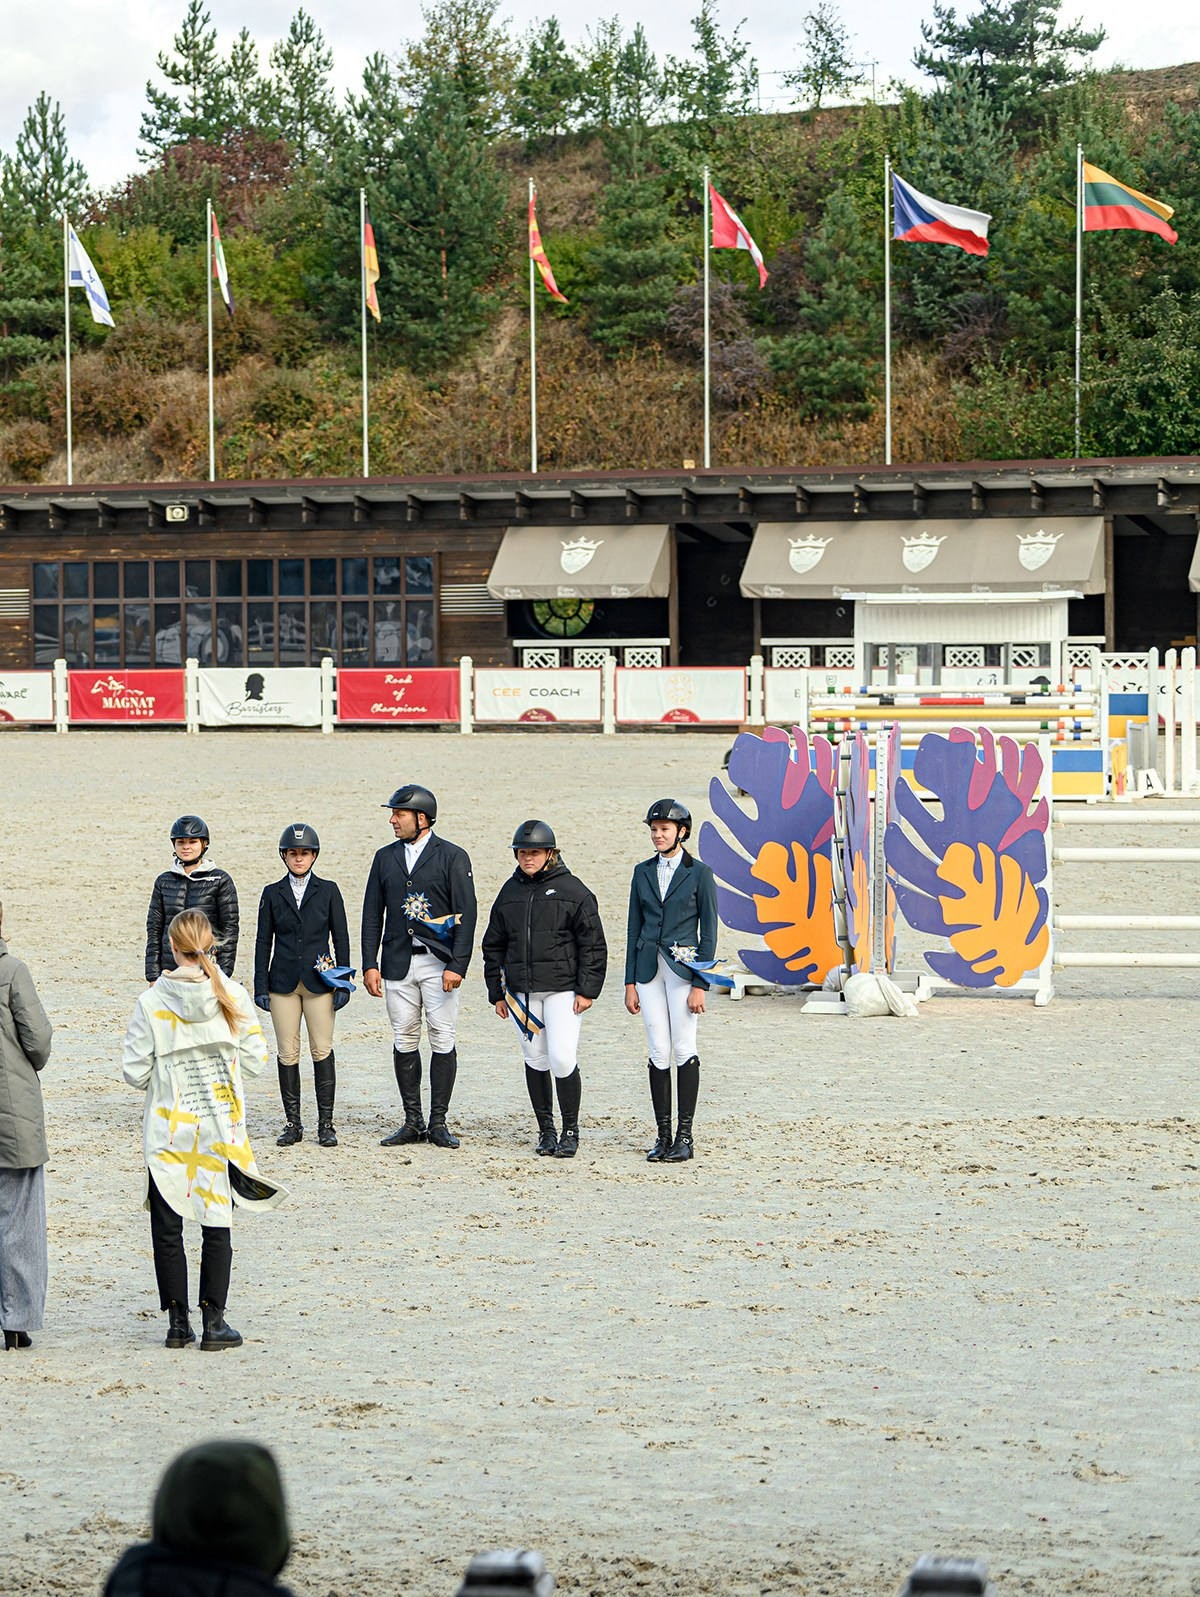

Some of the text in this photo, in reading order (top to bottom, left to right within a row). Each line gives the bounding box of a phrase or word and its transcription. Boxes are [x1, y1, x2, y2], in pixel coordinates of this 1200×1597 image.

[384, 674, 413, 684] Road
[392, 687, 406, 702] of
[492, 688, 580, 697] CEE COACH
[102, 696, 156, 709] MAGNAT
[129, 708, 155, 717] shop
[370, 703, 429, 717] Champions
[1145, 773, 1155, 790] A
